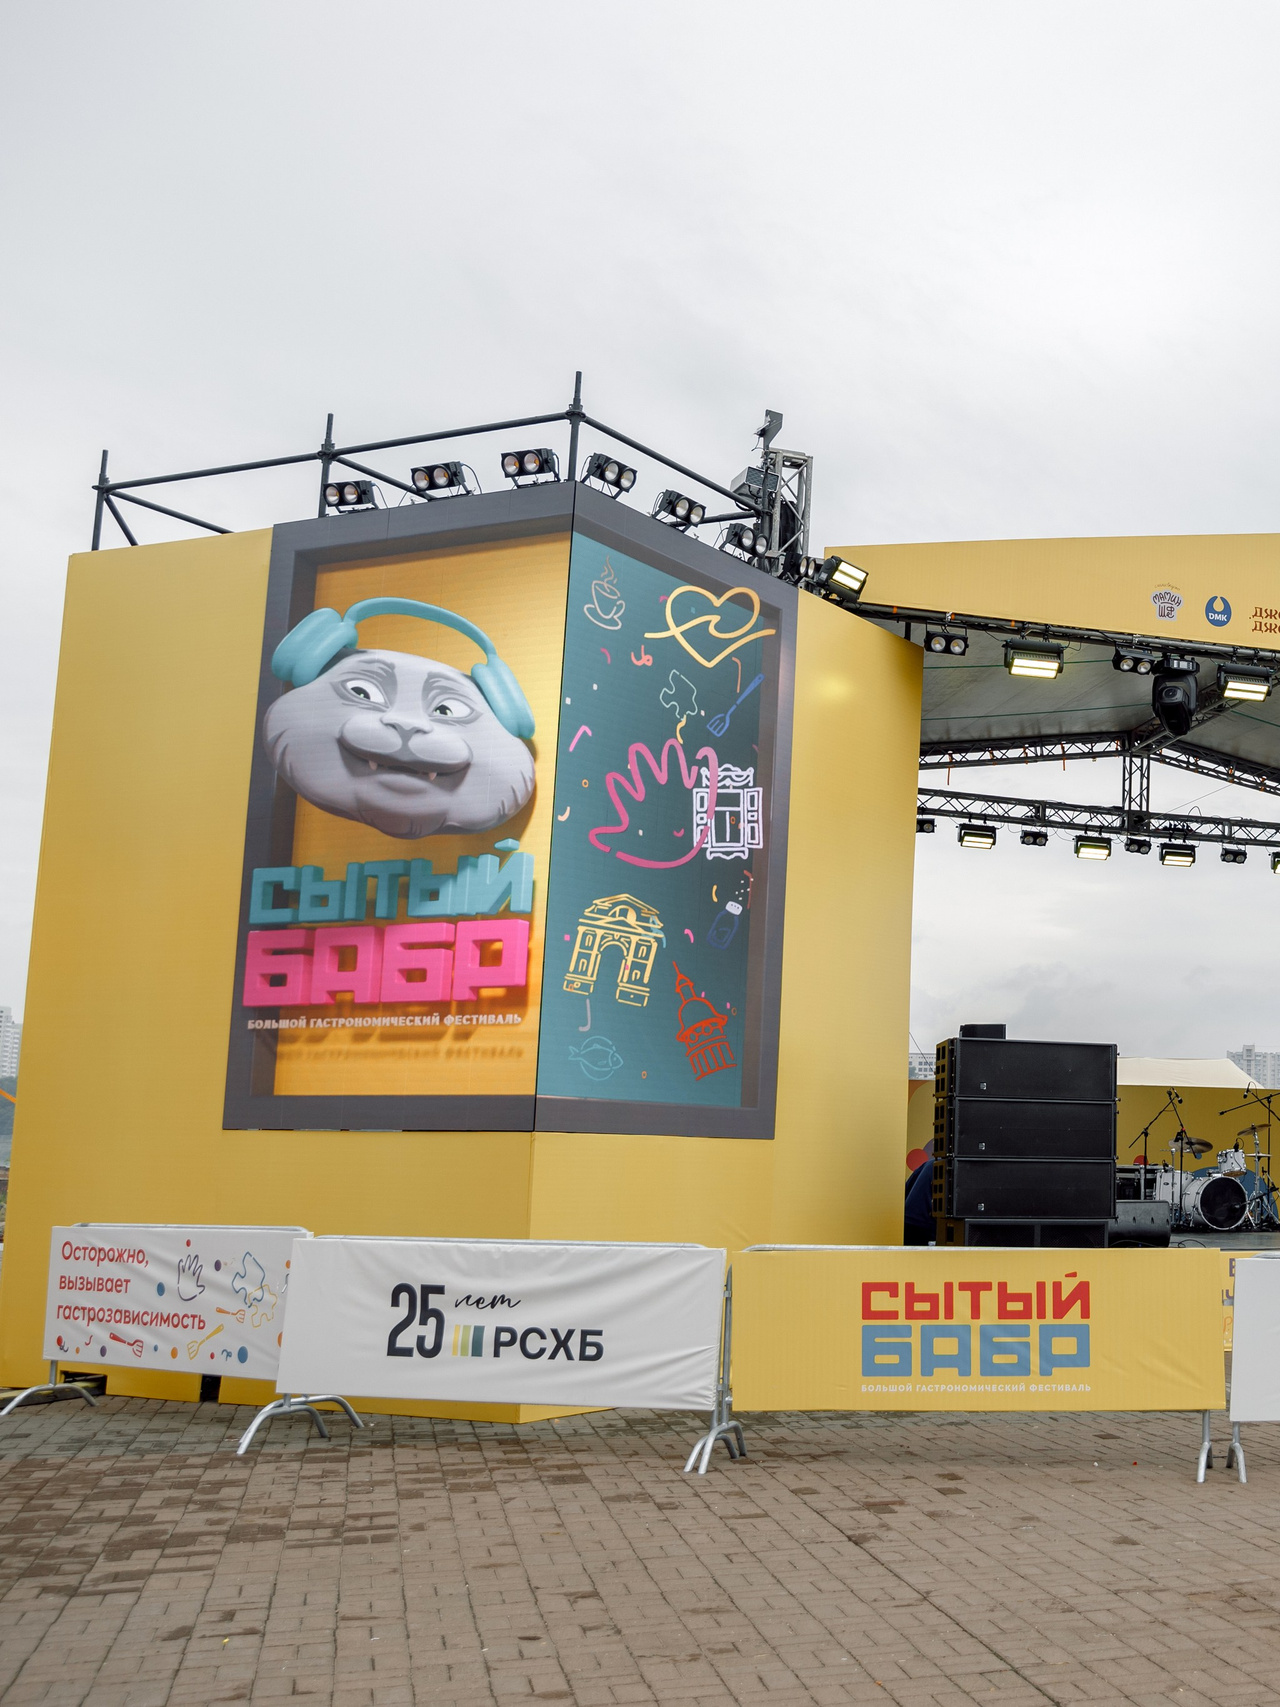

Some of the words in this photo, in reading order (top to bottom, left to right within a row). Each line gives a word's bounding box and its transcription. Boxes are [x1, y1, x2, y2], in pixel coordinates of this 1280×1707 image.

[248, 837, 535, 925] СЫТЫЙ
[242, 918, 531, 1007] БАБР
[247, 1016, 307, 1030] БОЛЬШОЙ
[309, 1012, 440, 1028] ГАСТРОНОМИЧЕСКИЙ
[443, 1013, 522, 1026] ФЕСТИВАЛЬ
[61, 1240, 150, 1267] Осторожно,
[58, 1274, 131, 1294] вызывает
[861, 1271, 1091, 1320] СЫТЫЙ
[56, 1302, 207, 1331] гастрозависимость
[386, 1282, 446, 1359] 25
[454, 1293, 522, 1310] лет
[493, 1325, 605, 1362] РСХБ
[861, 1323, 1091, 1377] БАБР
[861, 1382, 913, 1393] БОЛЬШОЙ
[915, 1382, 1026, 1393] ГАСТРОНОМИЧЕСКИЙ
[1029, 1383, 1092, 1393] ФЕСТИВАЛЬ
